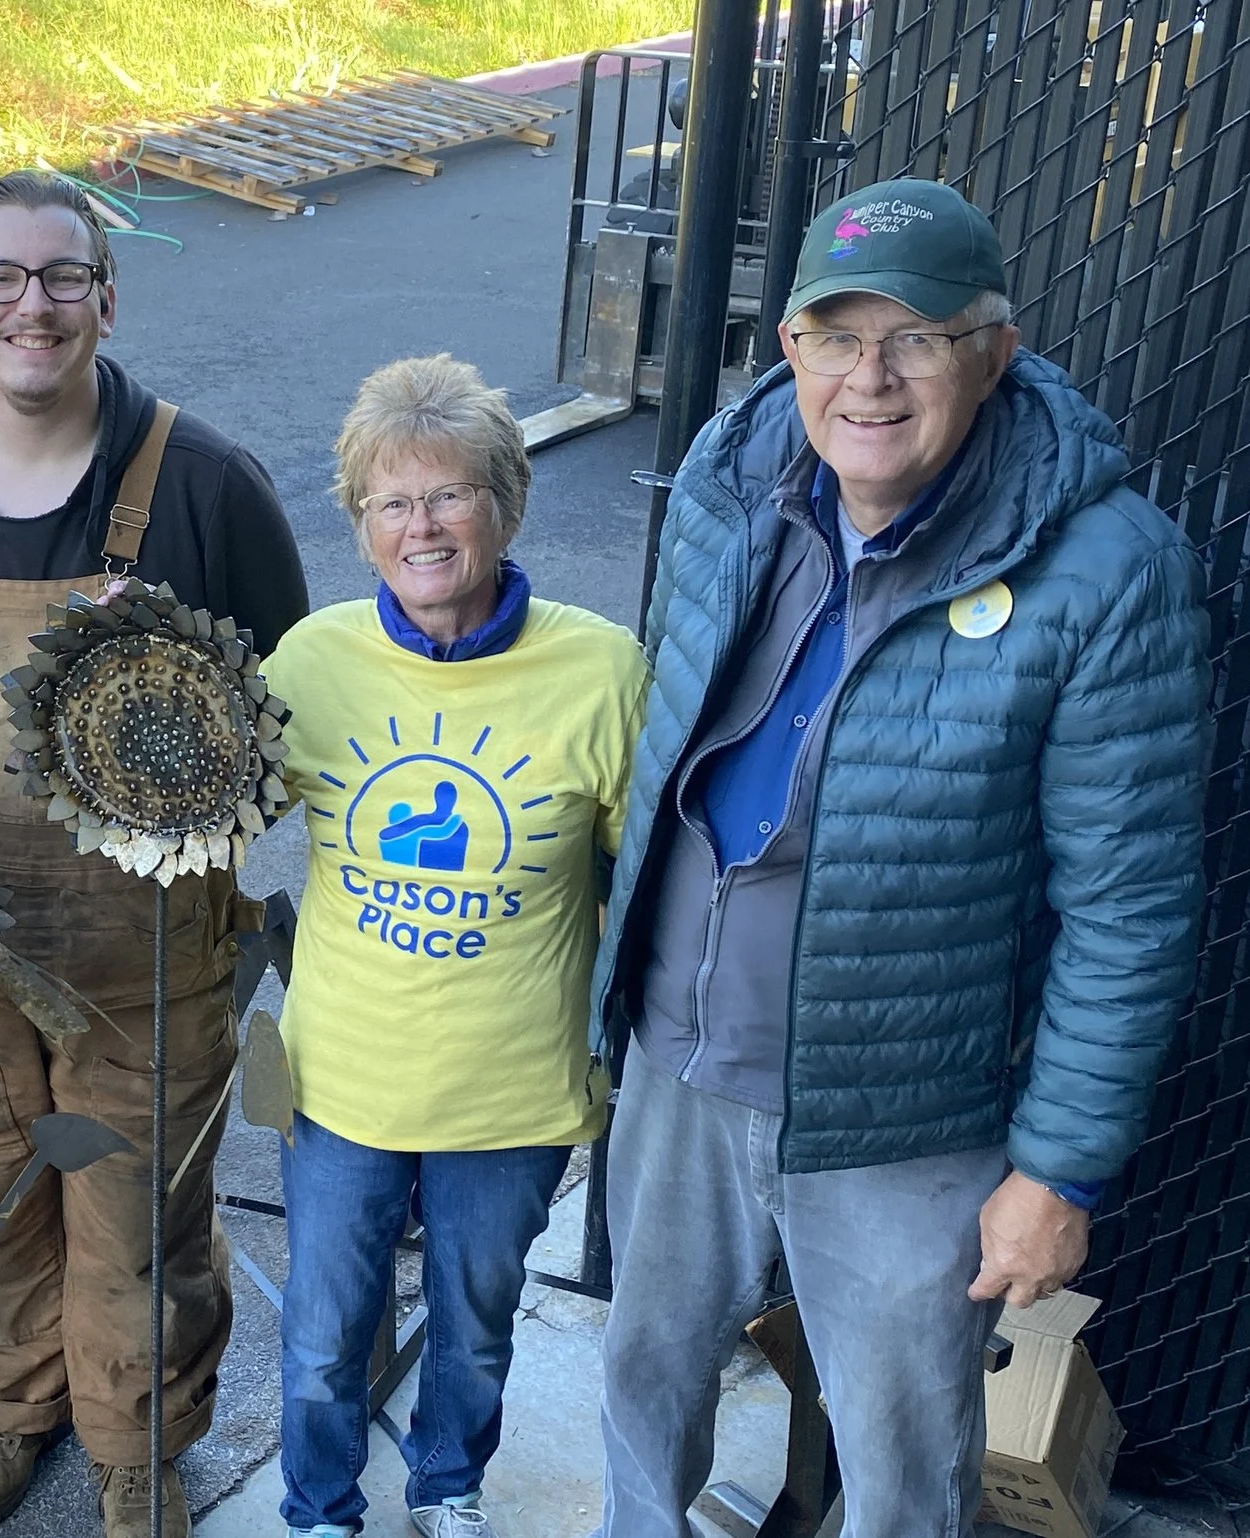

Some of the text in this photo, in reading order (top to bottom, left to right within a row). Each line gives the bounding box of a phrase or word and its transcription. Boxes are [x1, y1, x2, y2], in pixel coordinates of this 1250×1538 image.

[891, 199, 934, 220] Canyon
[860, 215, 913, 226] Country
[870, 223, 900, 233] Club
[340, 864, 522, 919] Cason's
[358, 902, 486, 959] Place
